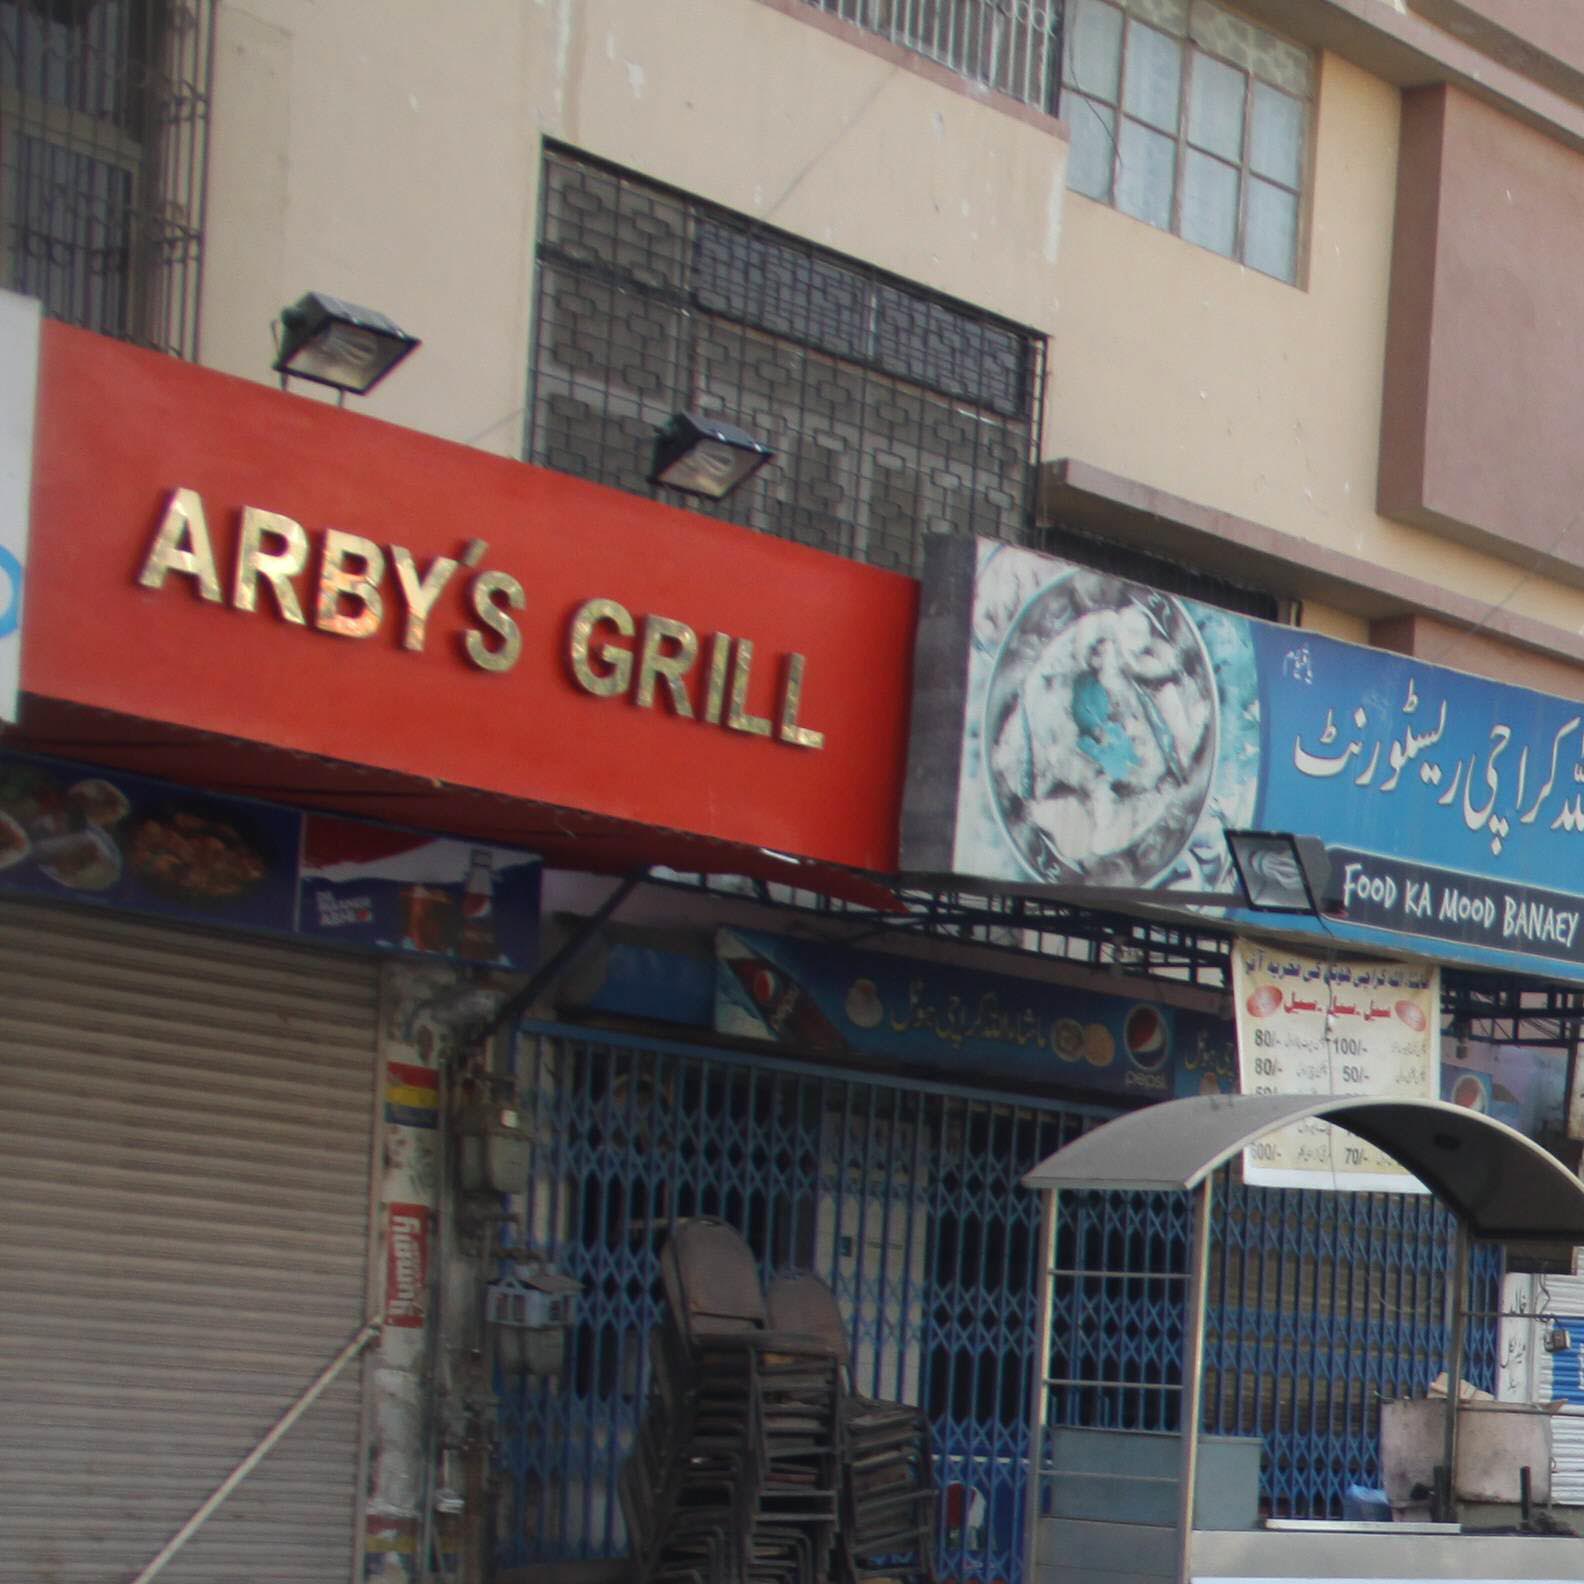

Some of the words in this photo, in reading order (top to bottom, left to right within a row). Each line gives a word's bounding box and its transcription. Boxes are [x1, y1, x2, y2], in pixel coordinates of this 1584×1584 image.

[138, 486, 528, 672] ARBY'S
[568, 597, 826, 750] GRILL
[1463, 716, 1580, 854] کراچی
[1343, 863, 1396, 908] FOOD
[1404, 879, 1433, 918] KA
[1440, 889, 1495, 930] MOOD
[1503, 896, 1580, 948] BANAEY
